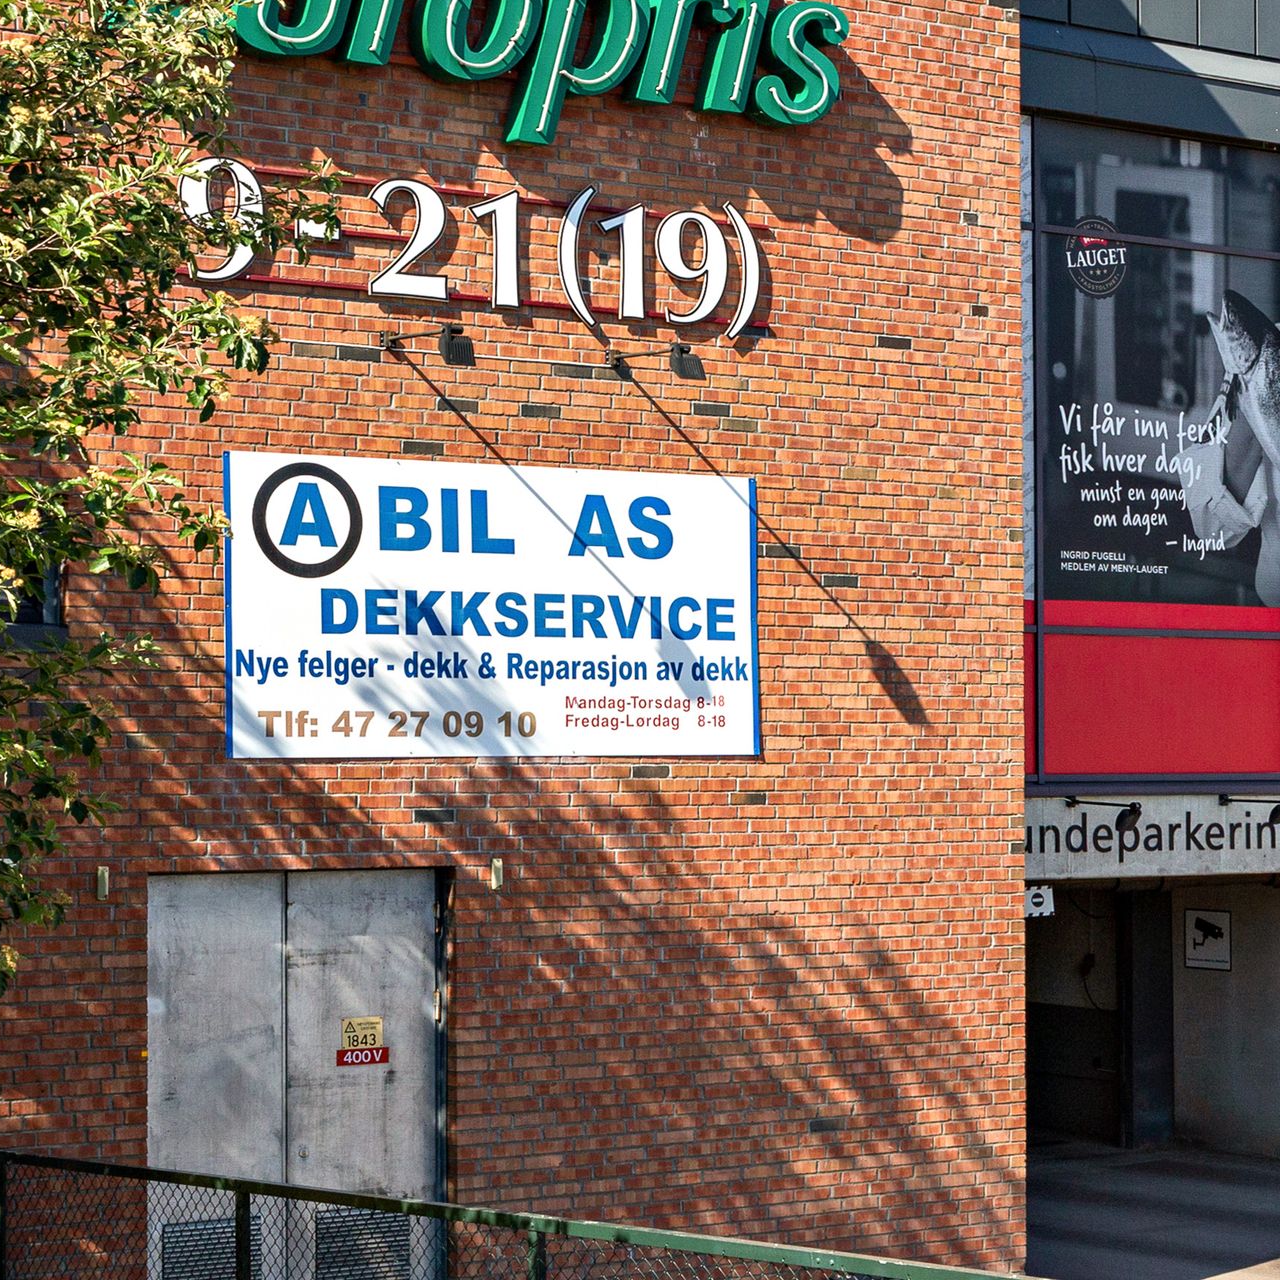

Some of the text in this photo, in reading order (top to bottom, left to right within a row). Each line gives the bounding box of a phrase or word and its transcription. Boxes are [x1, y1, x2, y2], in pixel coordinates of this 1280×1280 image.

[1065, 247, 1127, 268] LAUGET
[1059, 402, 1228, 453] Vi får inn fersk
[1059, 442, 1201, 487] fisk hver dag,
[1080, 480, 1186, 510] minst en gang
[378, 486, 515, 554] BIL
[568, 494, 674, 560] AS
[1093, 506, 1168, 535] om dagen
[1061, 551, 1126, 561] INGRID FUGELLI
[1183, 531, 1226, 560] Ingrid
[1061, 562, 1169, 574] MEDLEM AV MENY-LAUGET
[320, 588, 736, 642] DEKKSERVICE
[235, 649, 288, 685] Nye
[298, 650, 378, 686] felger
[404, 651, 468, 679] dekk
[478, 652, 496, 679] &
[507, 652, 648, 687] Reparasjon
[656, 660, 683, 681] av
[690, 656, 749, 681] dekk
[565, 695, 725, 712] Mandag-Torsdag 8-18
[257, 710, 537, 737] Tlf: 47 27 09 10
[565, 714, 726, 730] Fredag-Lørdag 8-18
[347, 1033, 377, 1047] 1843
[344, 1049, 382, 1063] 400 V
